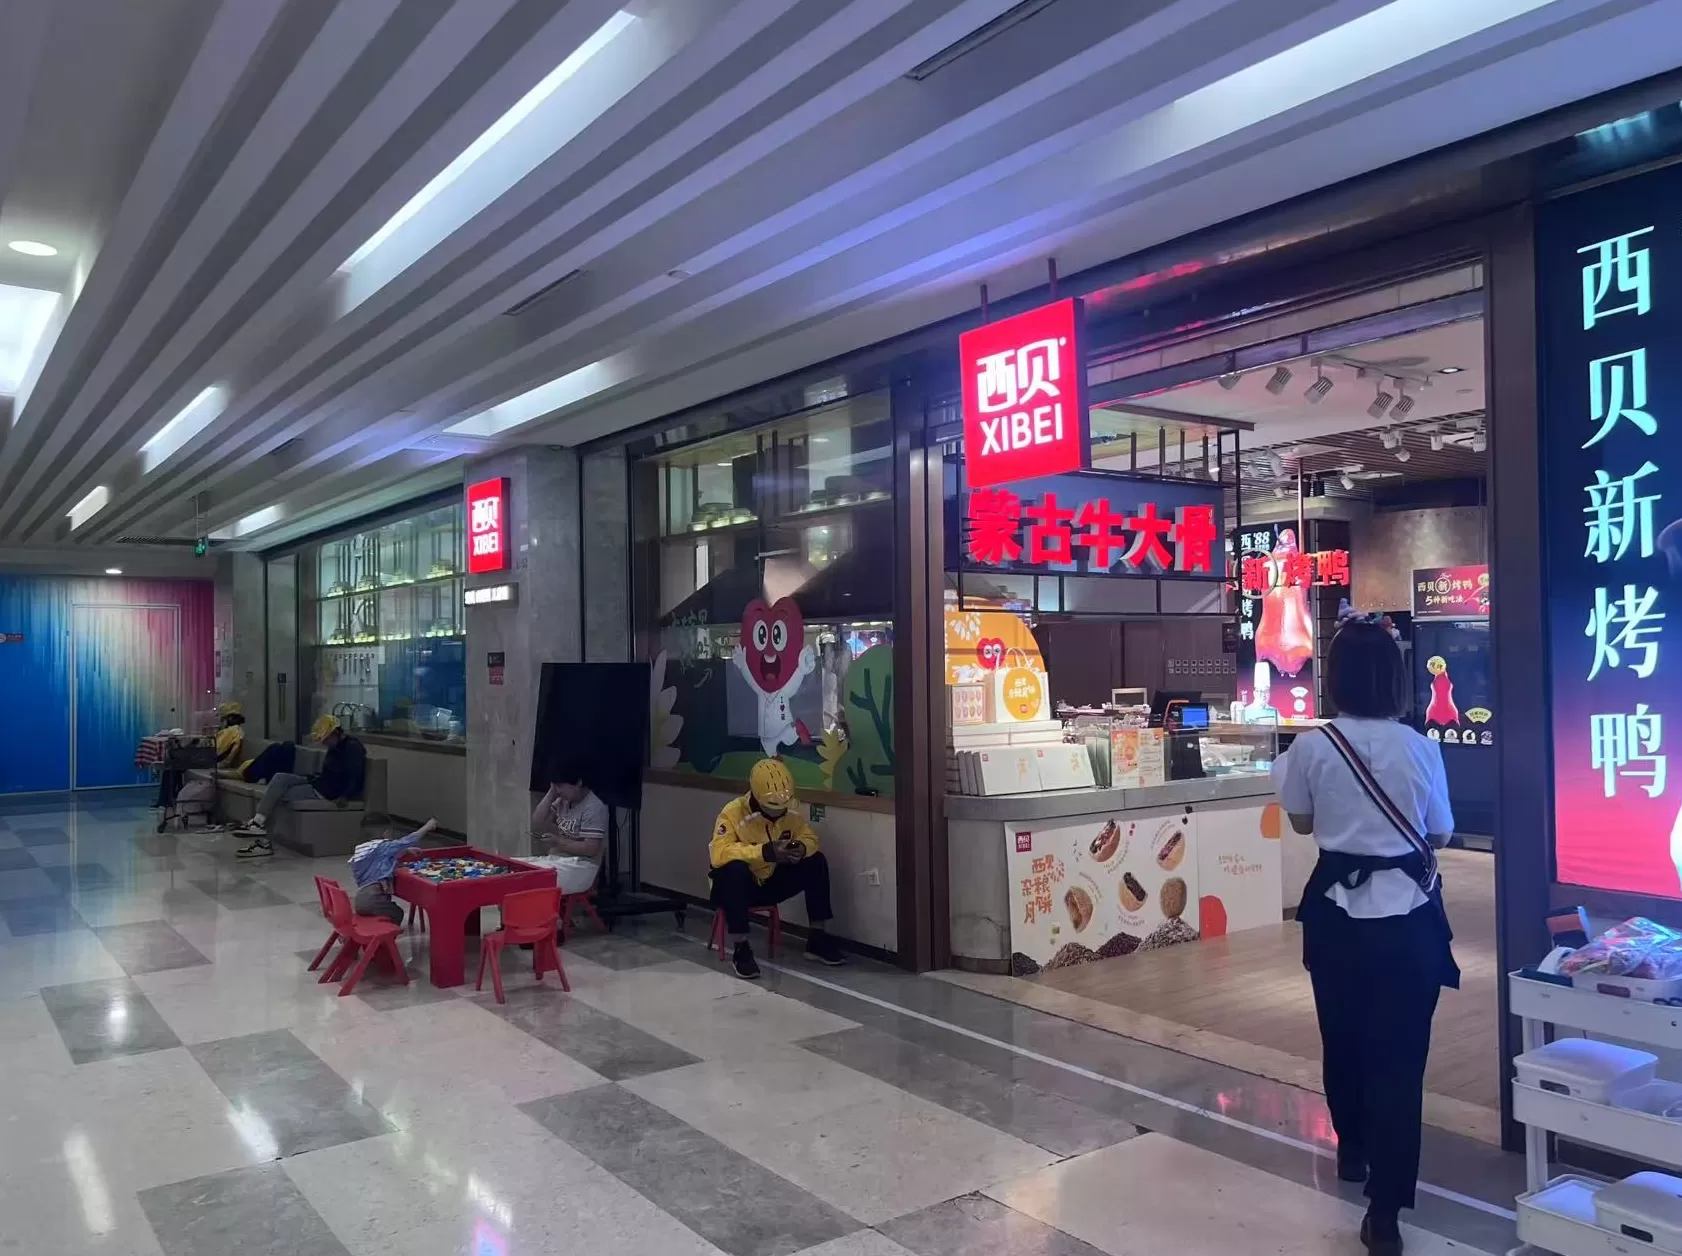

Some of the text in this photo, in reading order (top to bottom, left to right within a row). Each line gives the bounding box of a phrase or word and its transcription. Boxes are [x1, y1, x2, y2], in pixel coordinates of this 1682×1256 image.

[976, 338, 1061, 413] 西贝
[979, 403, 1064, 456] XIBEI
[967, 488, 1216, 572] 蒙古牛大骨
[1576, 226, 1667, 798] 西贝新烤鸭
